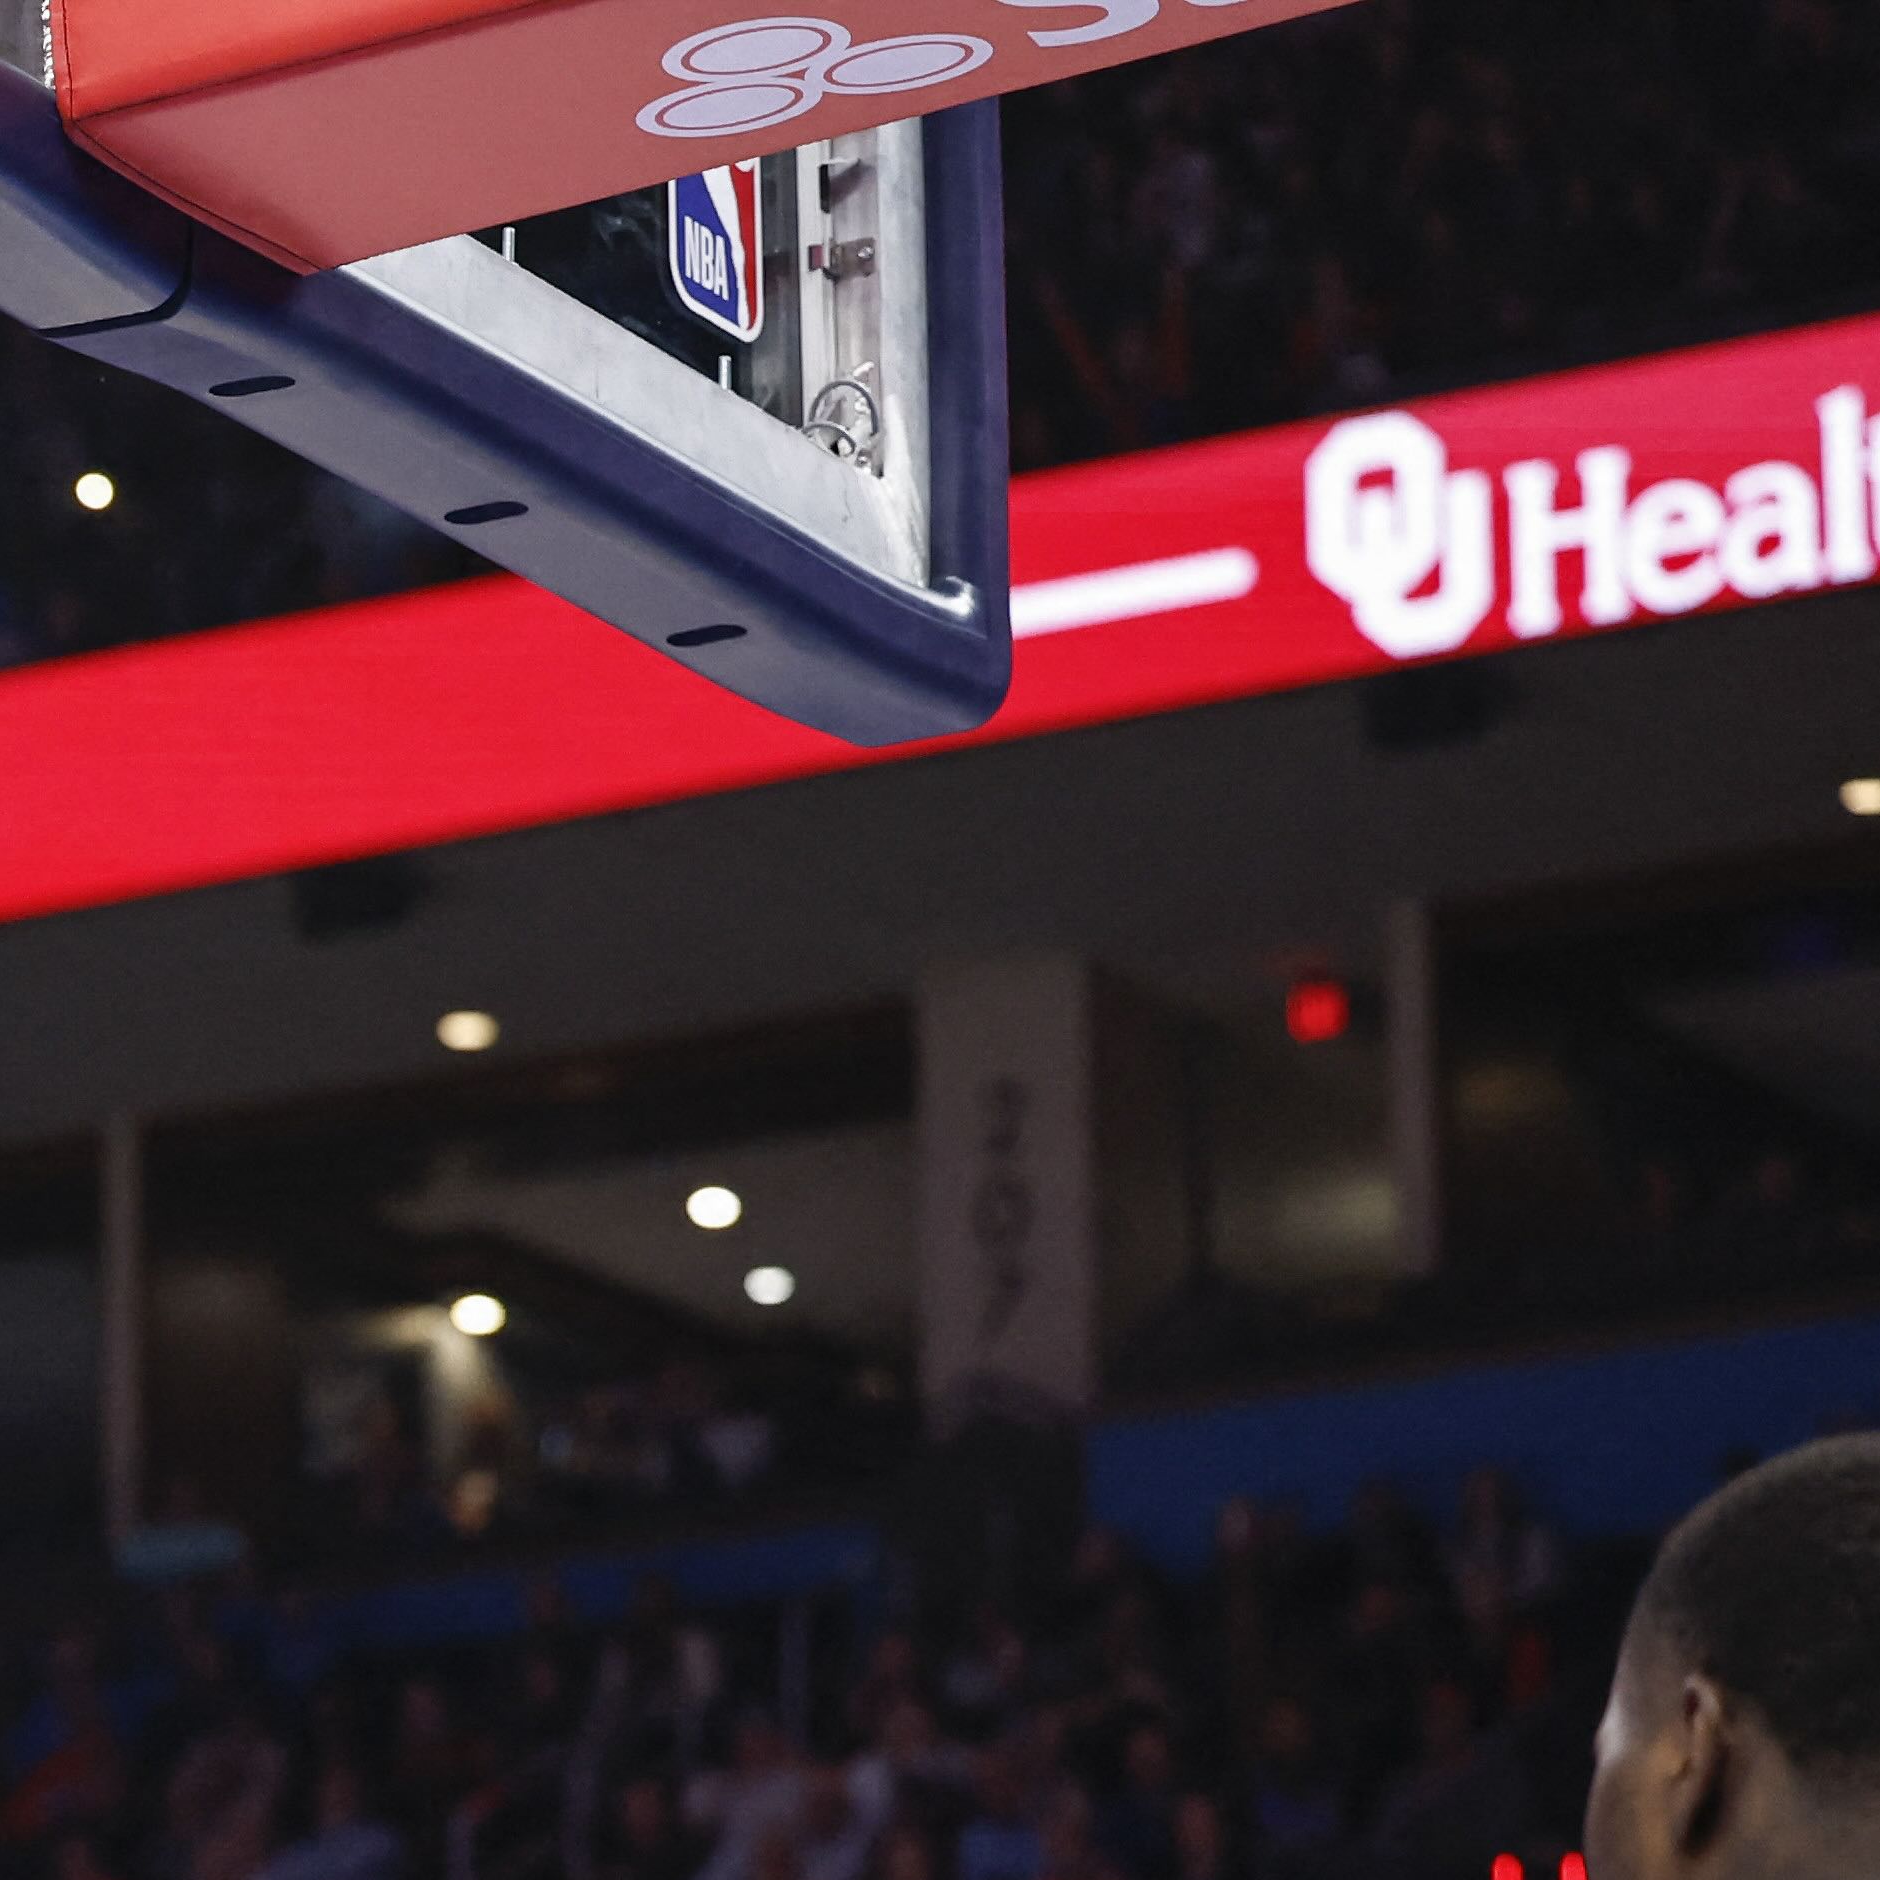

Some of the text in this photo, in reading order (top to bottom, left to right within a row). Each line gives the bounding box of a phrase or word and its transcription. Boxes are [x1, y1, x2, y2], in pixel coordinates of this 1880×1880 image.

[684, 215, 729, 301] NBA
[1303, 384, 1880, 661] OU Heal
